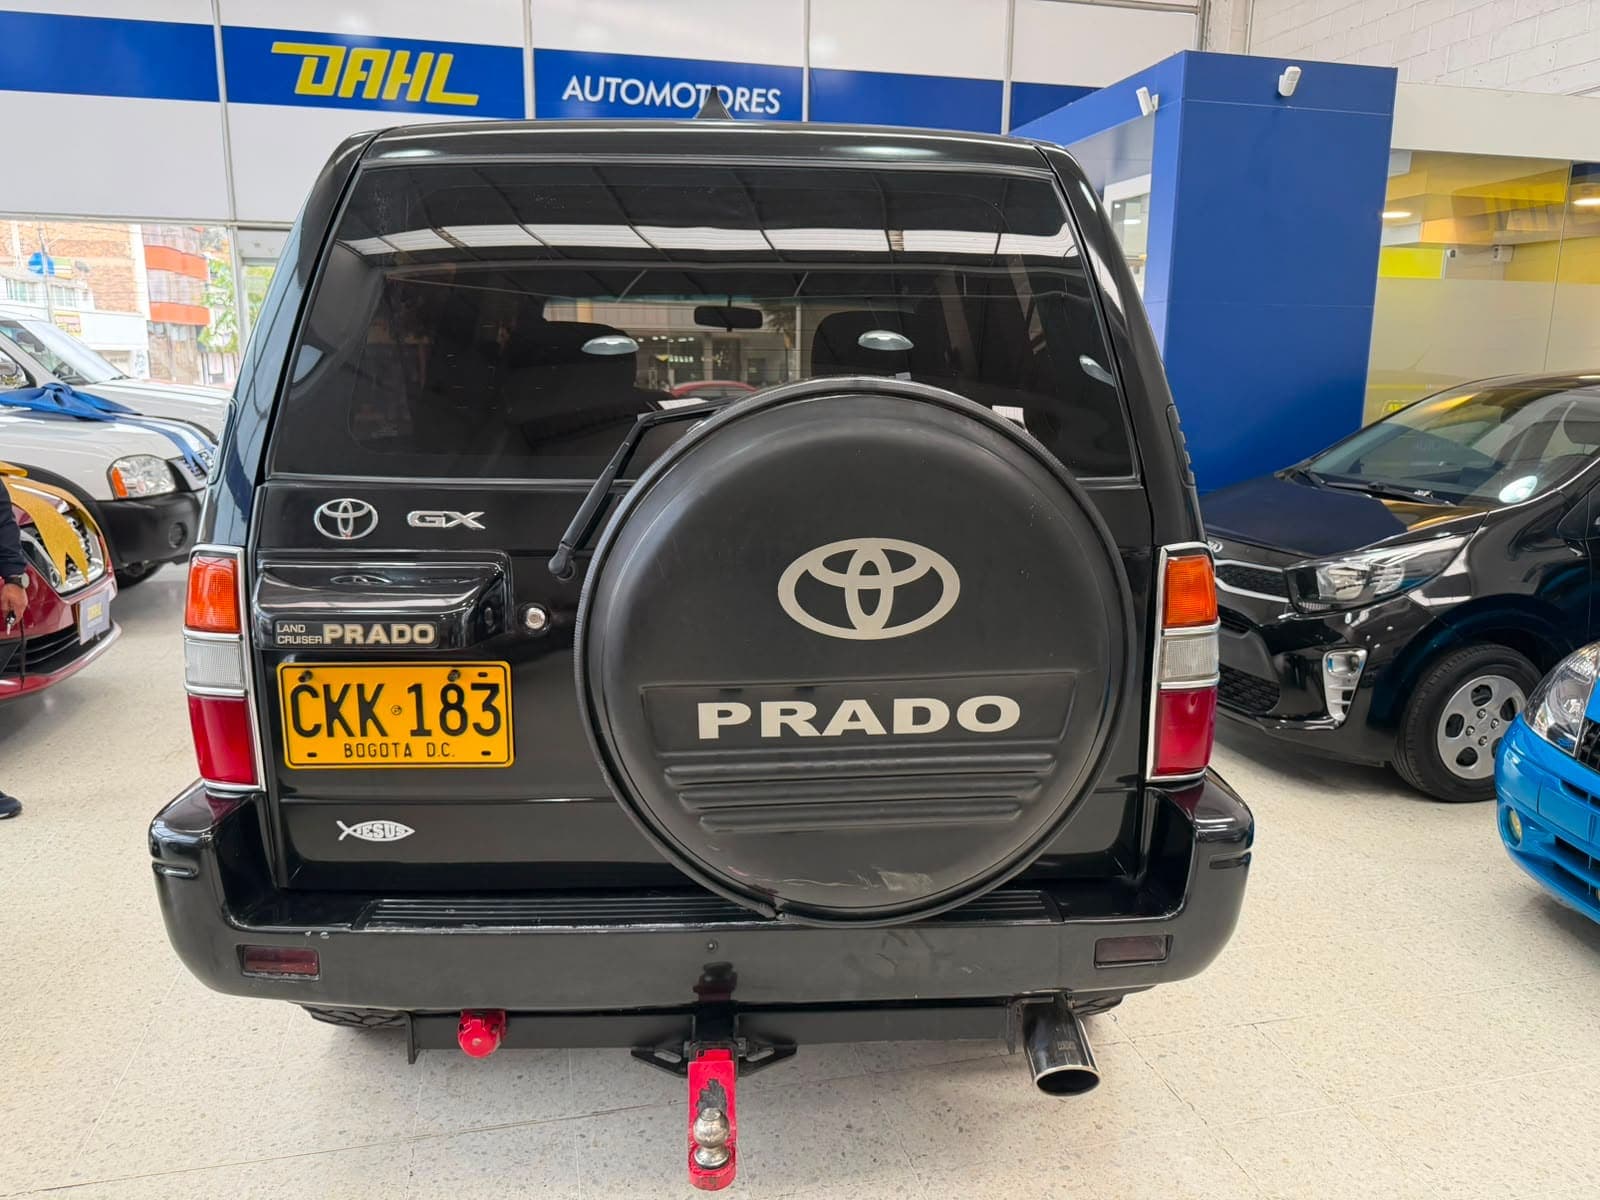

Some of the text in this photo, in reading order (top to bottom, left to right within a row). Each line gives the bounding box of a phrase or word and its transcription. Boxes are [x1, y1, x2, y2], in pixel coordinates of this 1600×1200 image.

[271, 41, 479, 106] DAHL
[407, 510, 486, 529] GX
[277, 624, 306, 634] LAND
[322, 623, 436, 645] PRADO
[277, 635, 322, 645] CRUISER
[290, 682, 502, 738] CKK 183
[697, 695, 1021, 739] PRADO
[343, 742, 412, 758] BOGOTA
